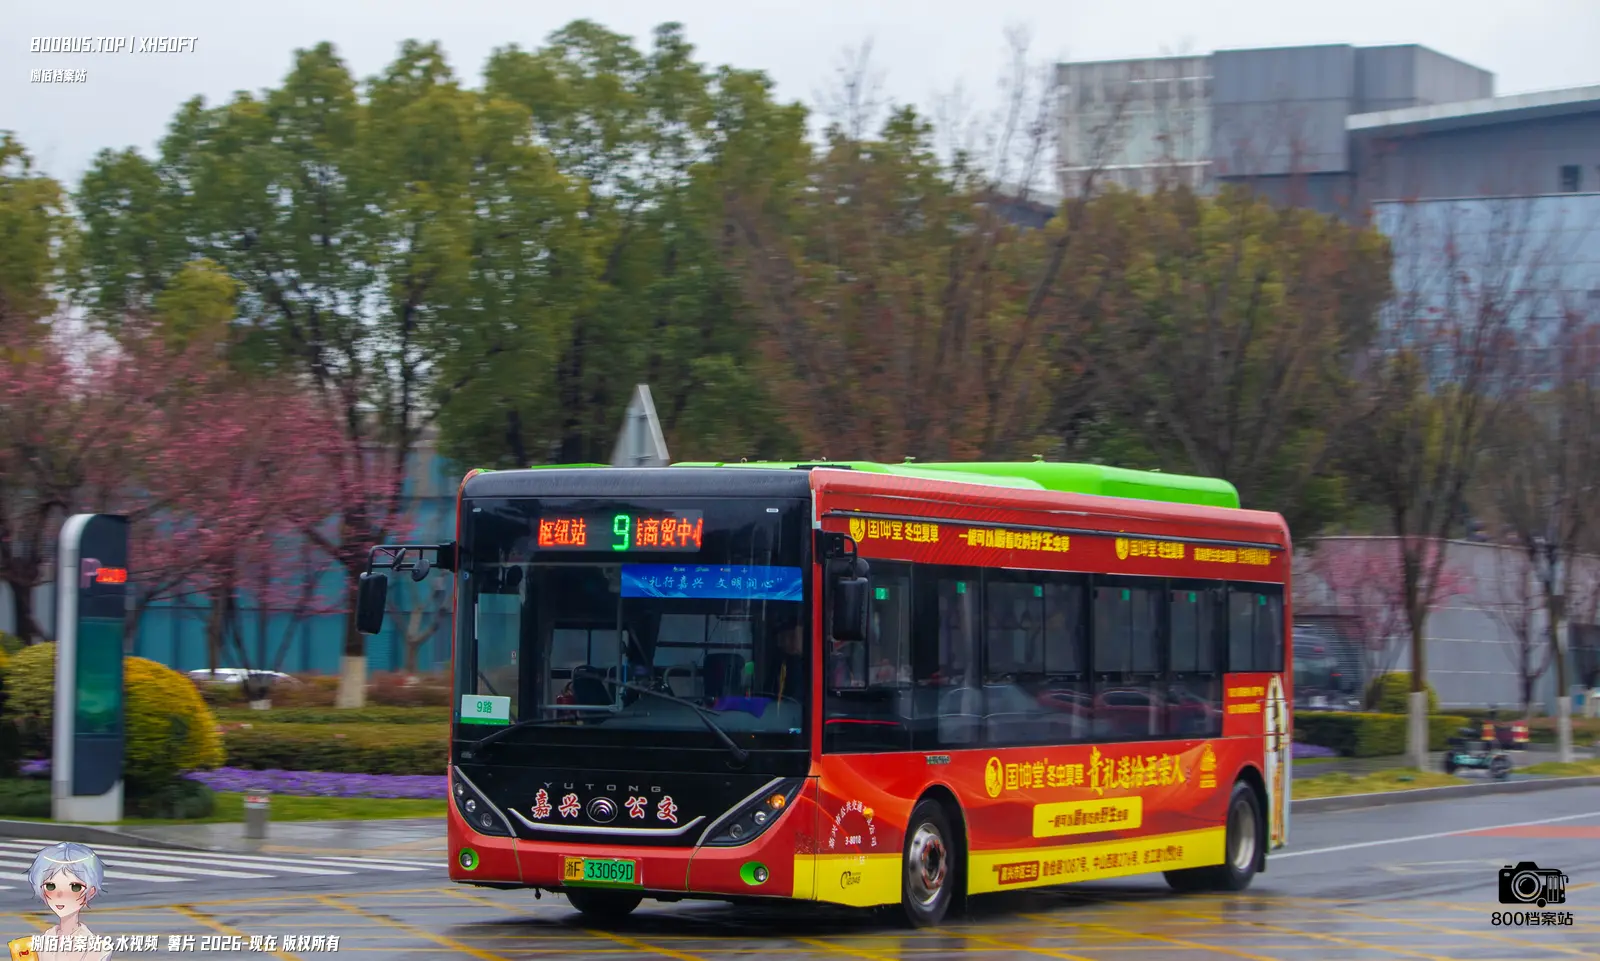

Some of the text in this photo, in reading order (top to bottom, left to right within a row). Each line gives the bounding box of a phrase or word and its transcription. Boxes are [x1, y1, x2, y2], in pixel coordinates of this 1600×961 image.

[612, 514, 630, 551] 9
[476, 700, 493, 713] 9路
[543, 781, 661, 793] YUTONG
